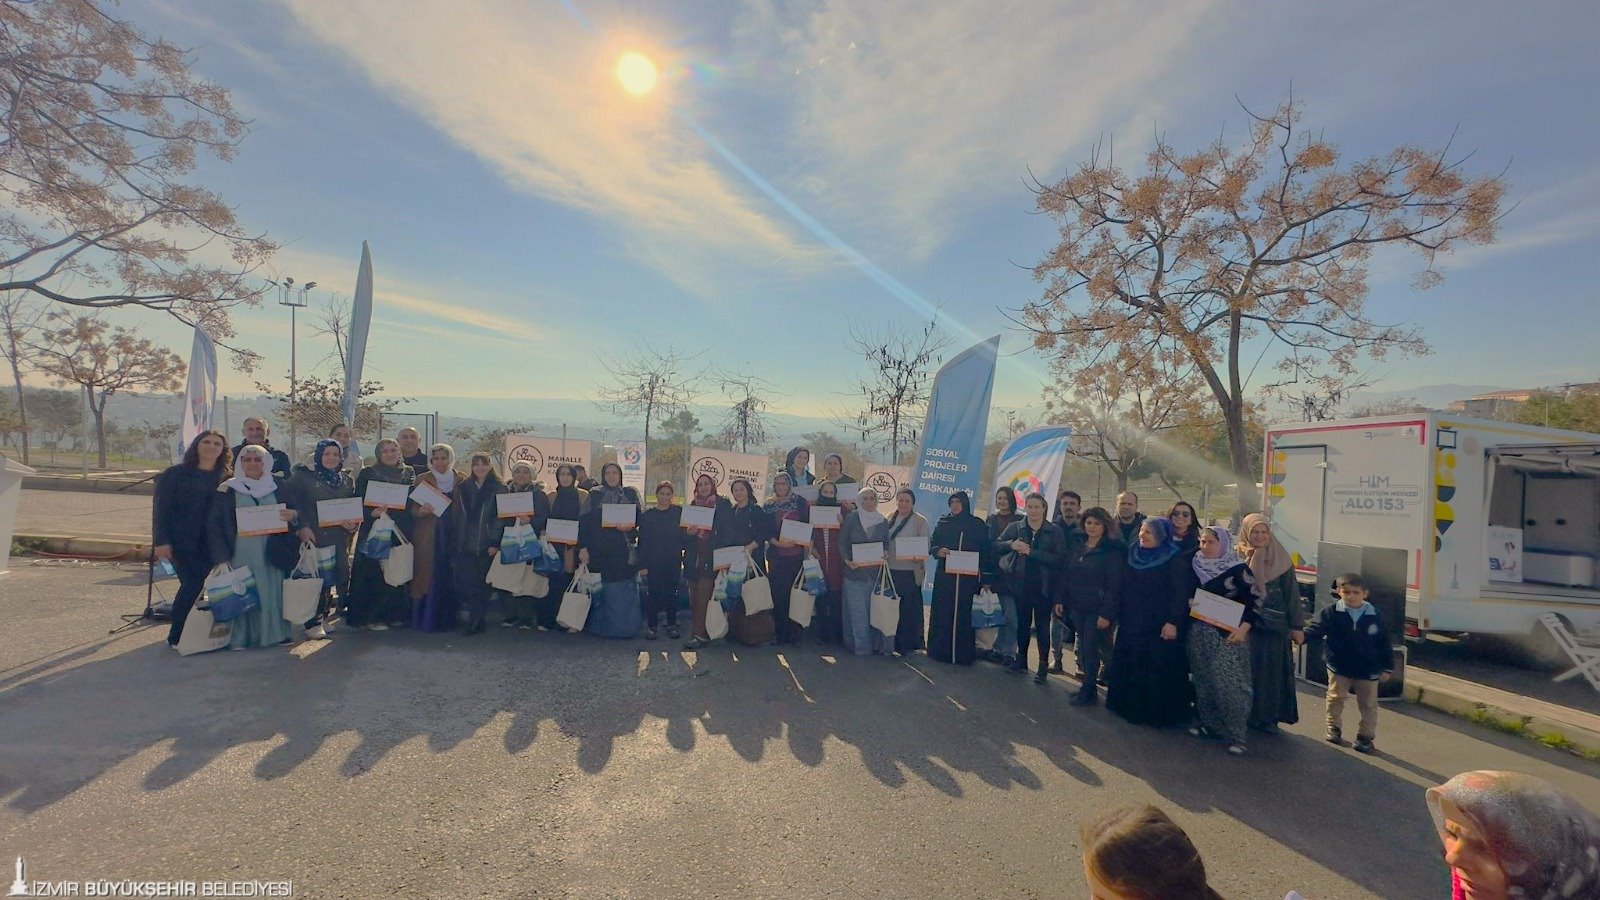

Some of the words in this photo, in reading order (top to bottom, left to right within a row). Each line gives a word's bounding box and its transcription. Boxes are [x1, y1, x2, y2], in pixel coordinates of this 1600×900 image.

[548, 455, 582, 463] MAHALLE
[925, 448, 960, 459] SOSYAL
[923, 460, 968, 472] PROJELER
[729, 469, 760, 477] MAHALLE
[921, 471, 956, 482] DAİRESİ
[1346, 498, 1375, 508] ALO
[1377, 498, 1404, 510] 153
